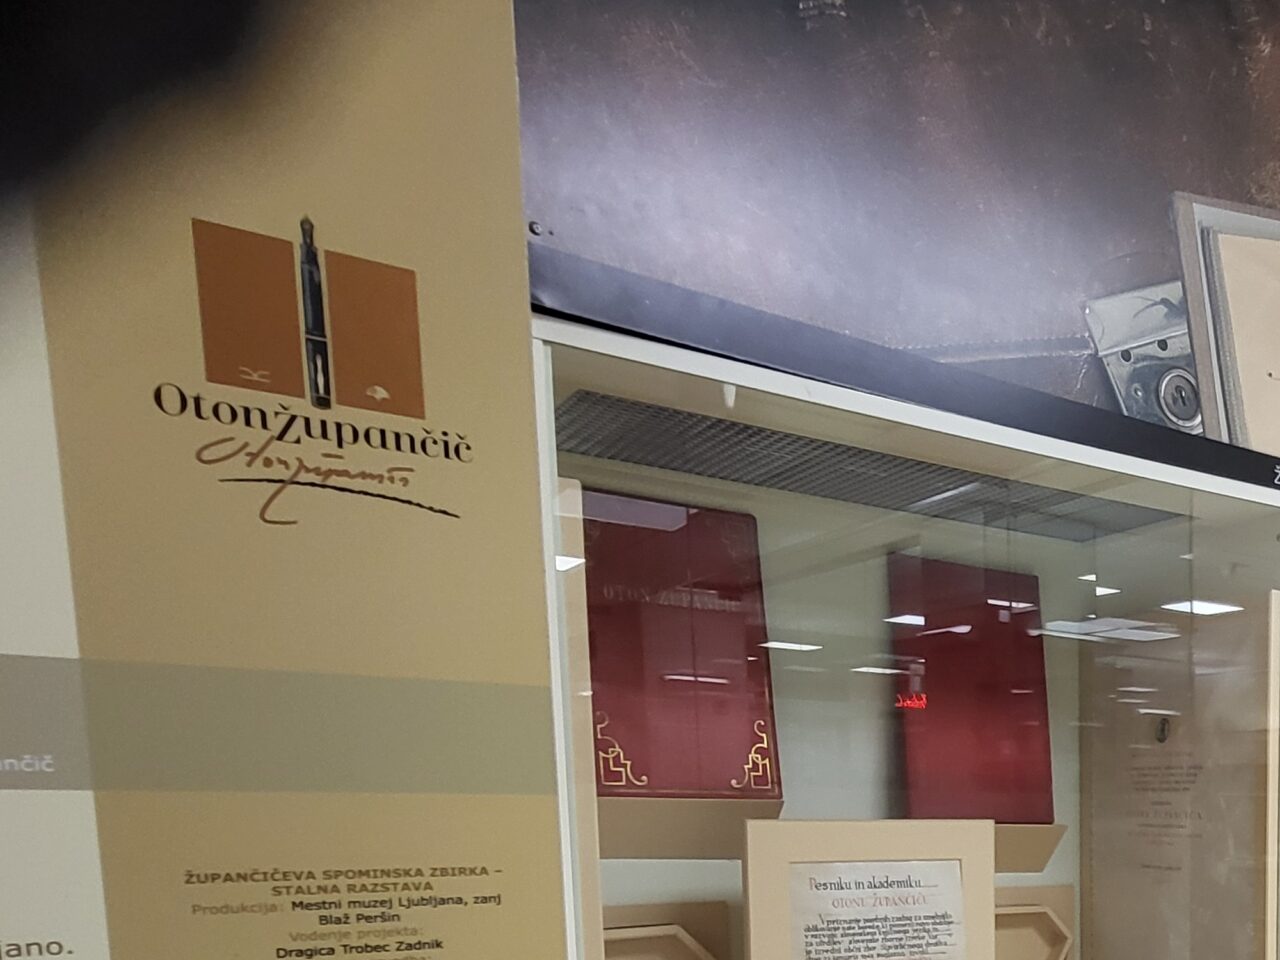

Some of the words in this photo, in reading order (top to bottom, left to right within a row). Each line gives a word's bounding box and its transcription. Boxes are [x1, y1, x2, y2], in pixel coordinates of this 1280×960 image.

[185, 868, 316, 884] ŽUPANČIČEVA
[322, 868, 424, 880] SPOMINSKA
[430, 866, 489, 877] ZBIRKA
[809, 875, 851, 891] Pesniku
[855, 877, 865, 890] in
[867, 875, 921, 889] akademiku
[271, 884, 340, 896] STALNA
[347, 881, 433, 893] RAZSTAVA
[291, 900, 342, 911] Mestni
[347, 898, 392, 910] muzej
[398, 896, 468, 909] Ljubljana,
[473, 894, 501, 905] zanj
[319, 913, 351, 925] Blaž
[356, 911, 400, 923] Peršin
[276, 946, 335, 959] Dragica
[340, 943, 390, 954] Trobec
[395, 939, 444, 952] Zadnik
